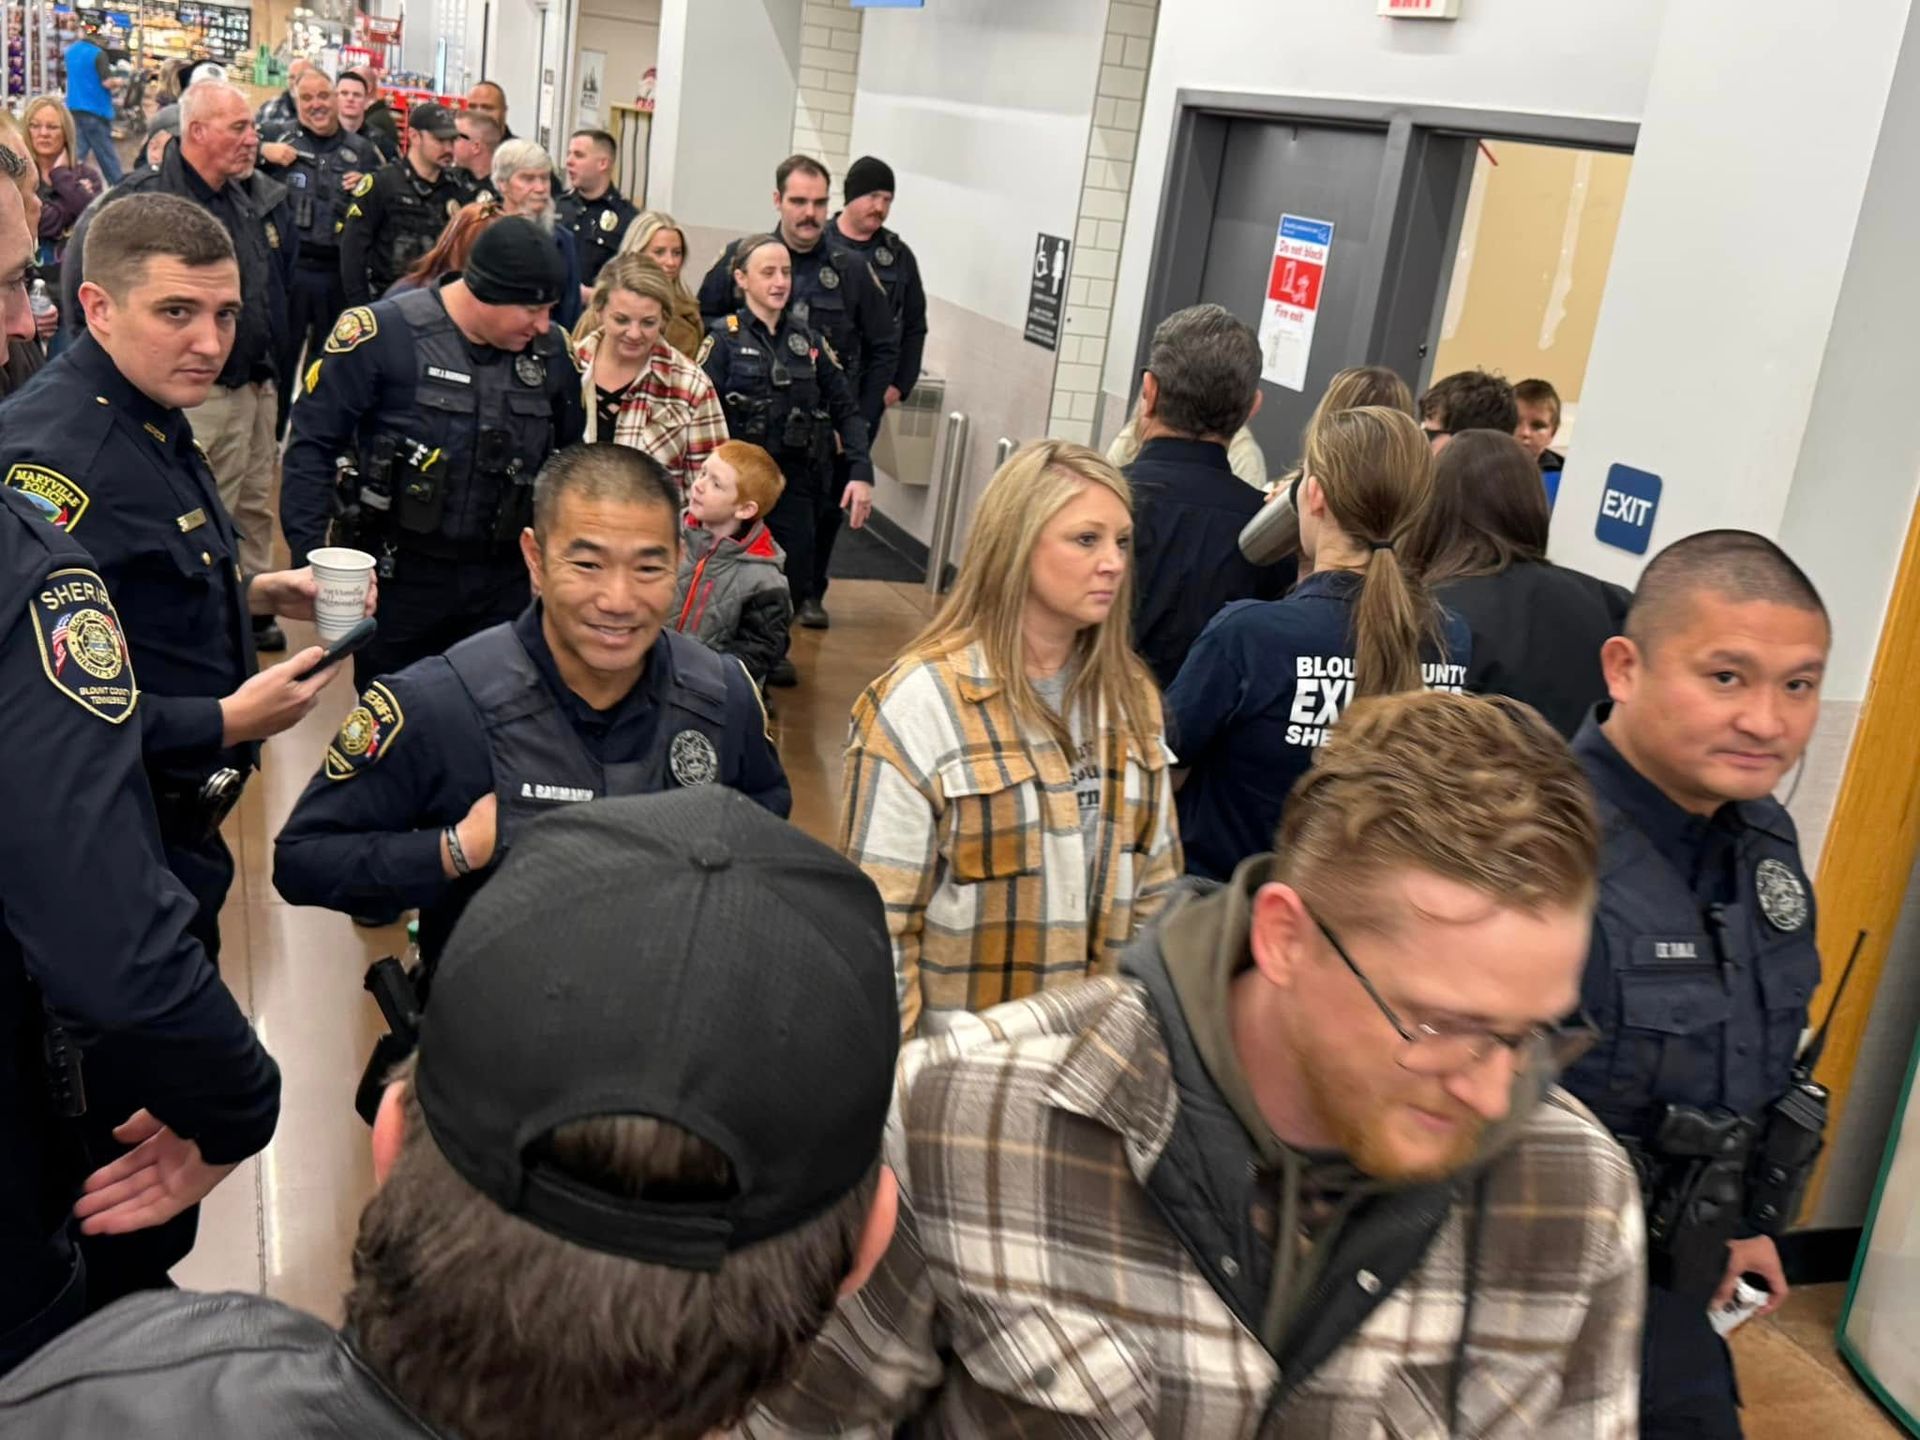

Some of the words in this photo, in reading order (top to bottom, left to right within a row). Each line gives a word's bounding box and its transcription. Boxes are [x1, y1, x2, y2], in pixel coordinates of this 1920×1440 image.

[14, 470, 80, 508] MARYVILLE
[22, 481, 66, 507] POLICE
[1602, 489, 1653, 527] EXIT
[41, 582, 108, 610] SHERIF
[1296, 656, 1356, 678] BLOU
[1420, 663, 1467, 685] UNTY
